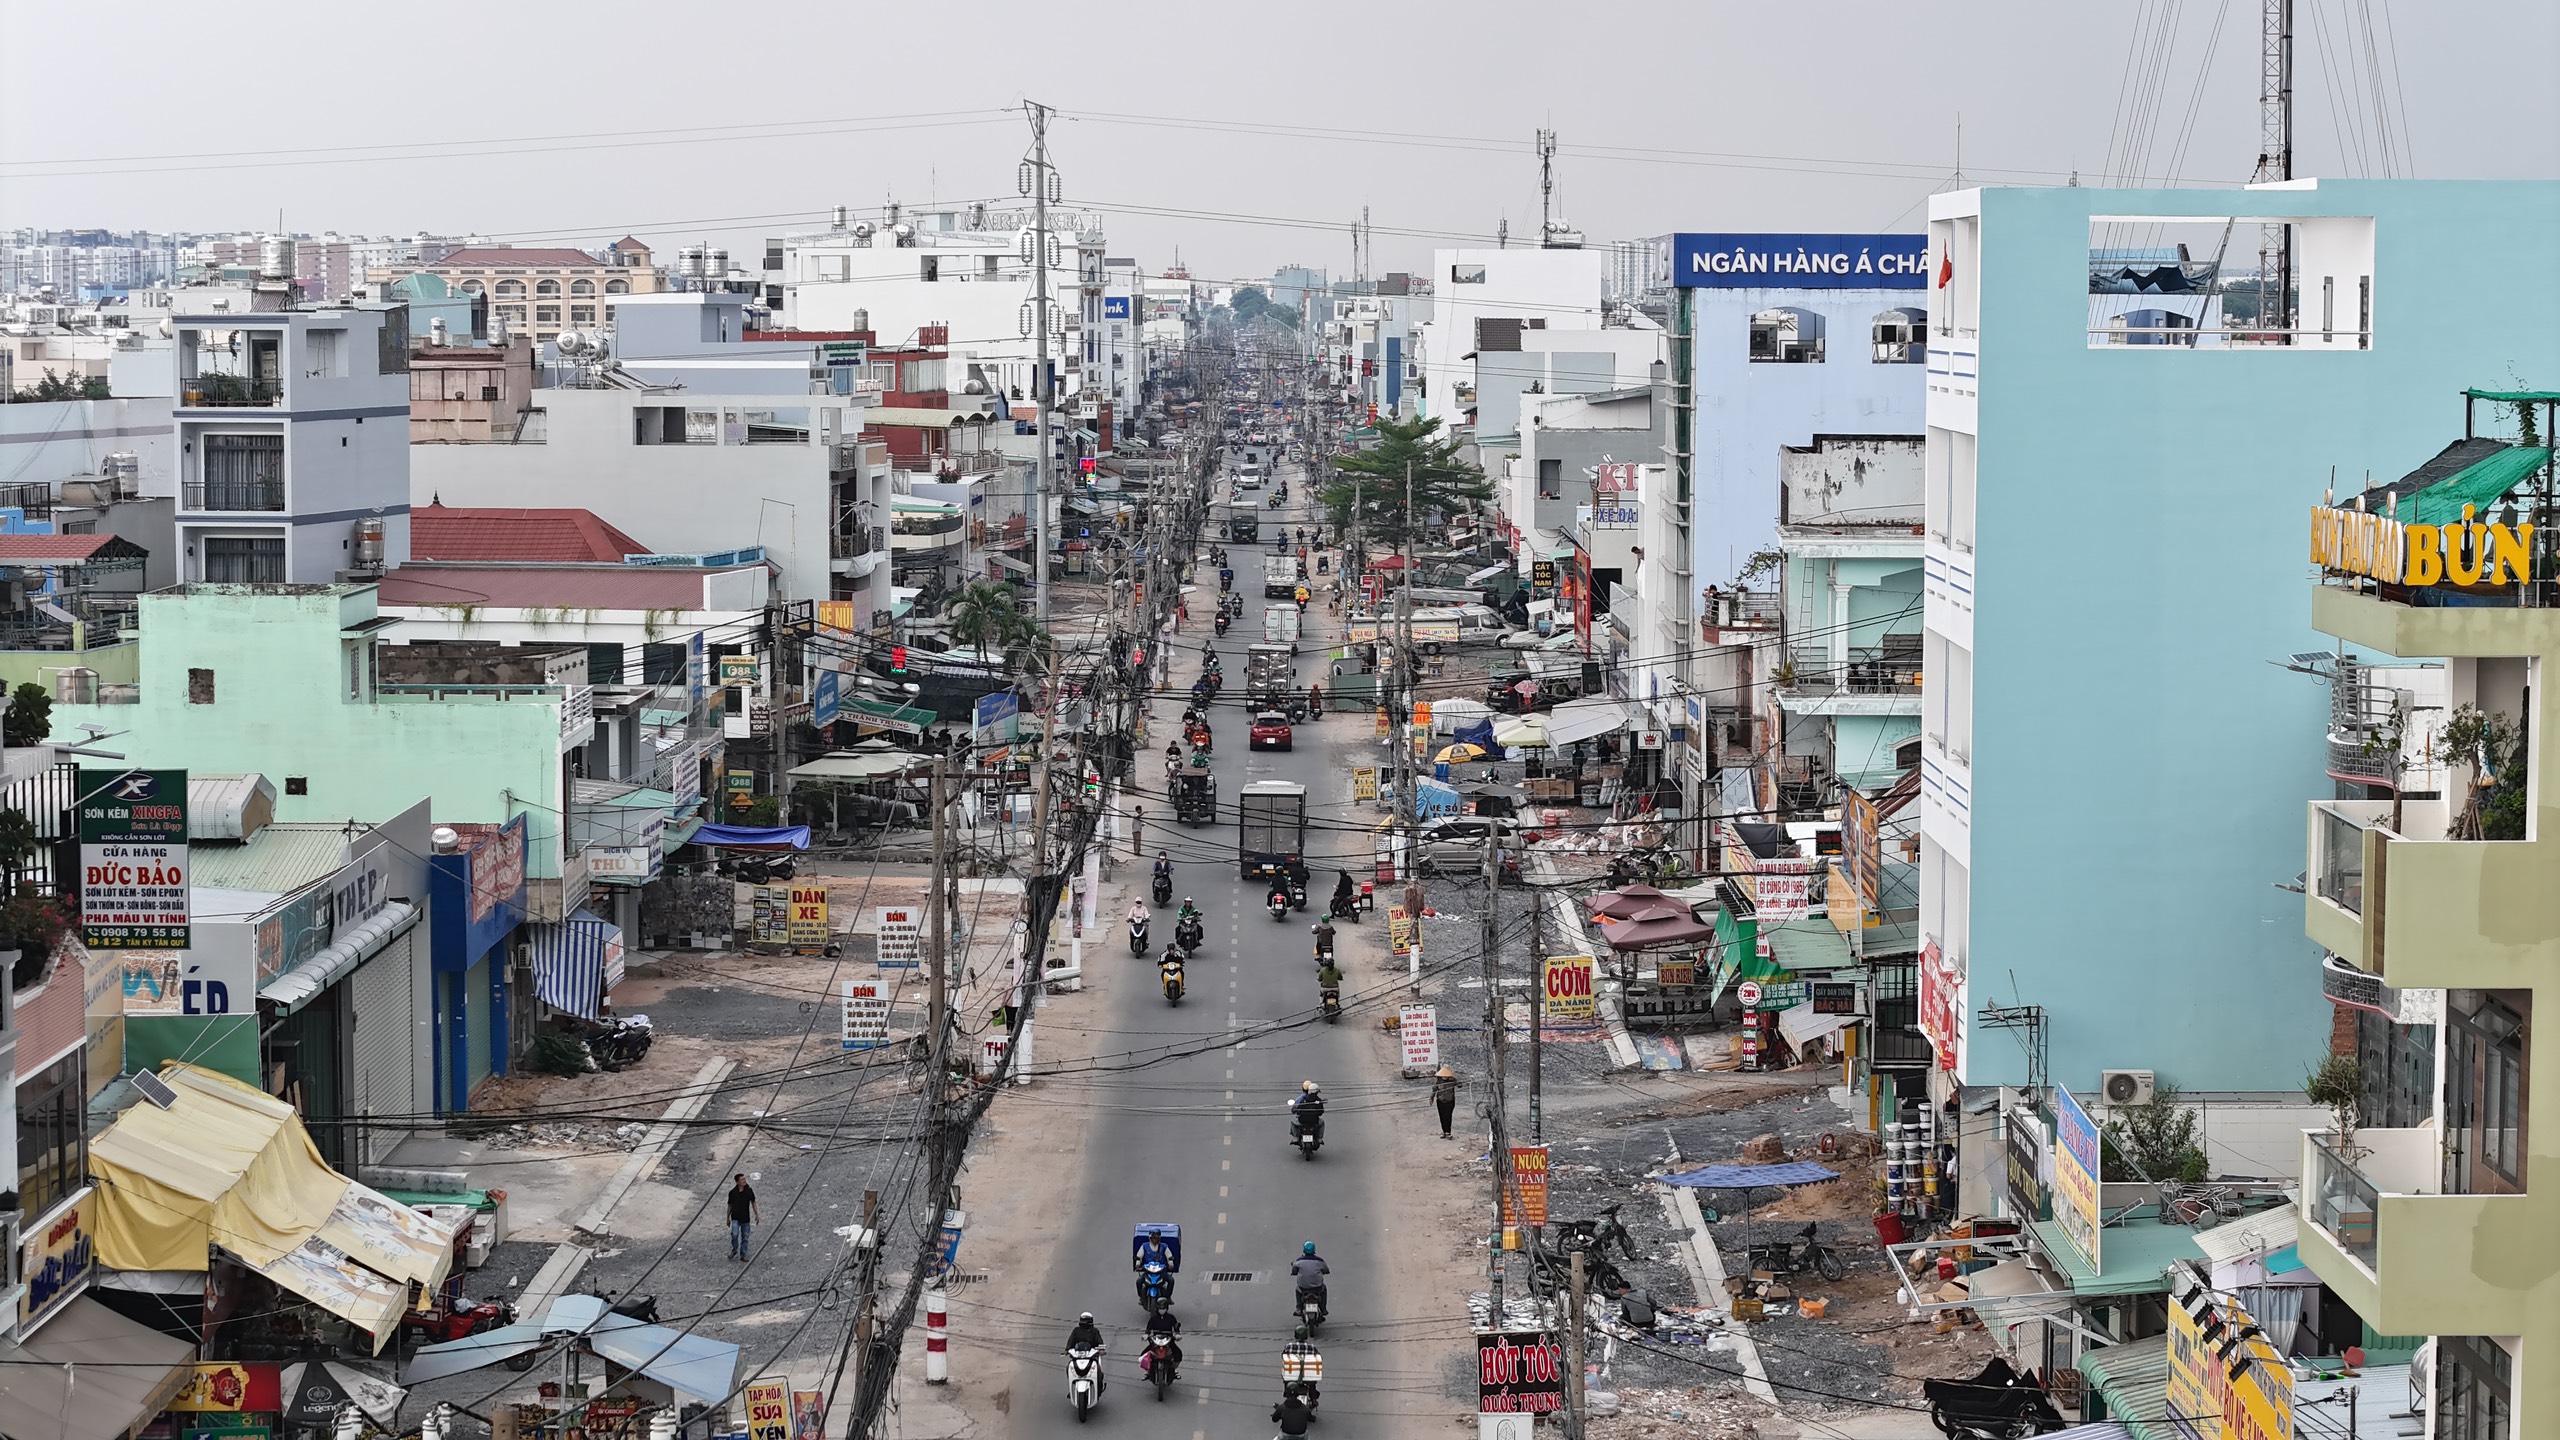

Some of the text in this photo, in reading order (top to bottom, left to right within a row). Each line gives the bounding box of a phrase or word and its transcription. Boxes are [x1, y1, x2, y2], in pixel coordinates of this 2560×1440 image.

[1692, 247, 1768, 273] NGÂN
[1774, 248, 1850, 273] HÀNG
[1855, 248, 1873, 274] Á
[2403, 503, 2534, 586] BÚN
[1536, 570, 1551, 578] TÓC
[820, 604, 832, 628] DÊ
[836, 603, 853, 629] NÚI
[880, 717, 909, 729] TRUNG
[731, 778, 750, 786] F88
[85, 806, 104, 819] SƠN
[132, 806, 182, 820] XINGFA
[134, 846, 167, 857] HÀNG
[592, 856, 626, 871] THÚ
[87, 858, 182, 886] ĐỨC BẢO
[86, 887, 101, 897] SƠN
[103, 886, 117, 897] LÓT
[159, 888, 184, 897] EPOXY
[337, 859, 377, 927] THÉP
[792, 888, 826, 904] DÁN
[86, 912, 186, 924] PHA MÀU VI TÍNH
[799, 906, 819, 920] XE
[886, 910, 908, 923] BÁN
[101, 928, 185, 937] 0908 79 55 86
[88, 937, 122, 946] 942
[126, 938, 141, 947] TÂN
[153, 938, 167, 947] TÂN
[1548, 962, 1591, 998] CƠM
[853, 984, 876, 998] BÁN
[1743, 1017, 1757, 1026] DÁN
[1518, 1150, 1546, 1170] NƯỚC
[1517, 1171, 1545, 1184] TÁM
[1480, 1334, 1562, 1385] HỚT TÓC
[1482, 1386, 1562, 1413] QUỐC TRUNG
[753, 1404, 783, 1421] SỮA
[754, 1420, 787, 1440] YẾN
